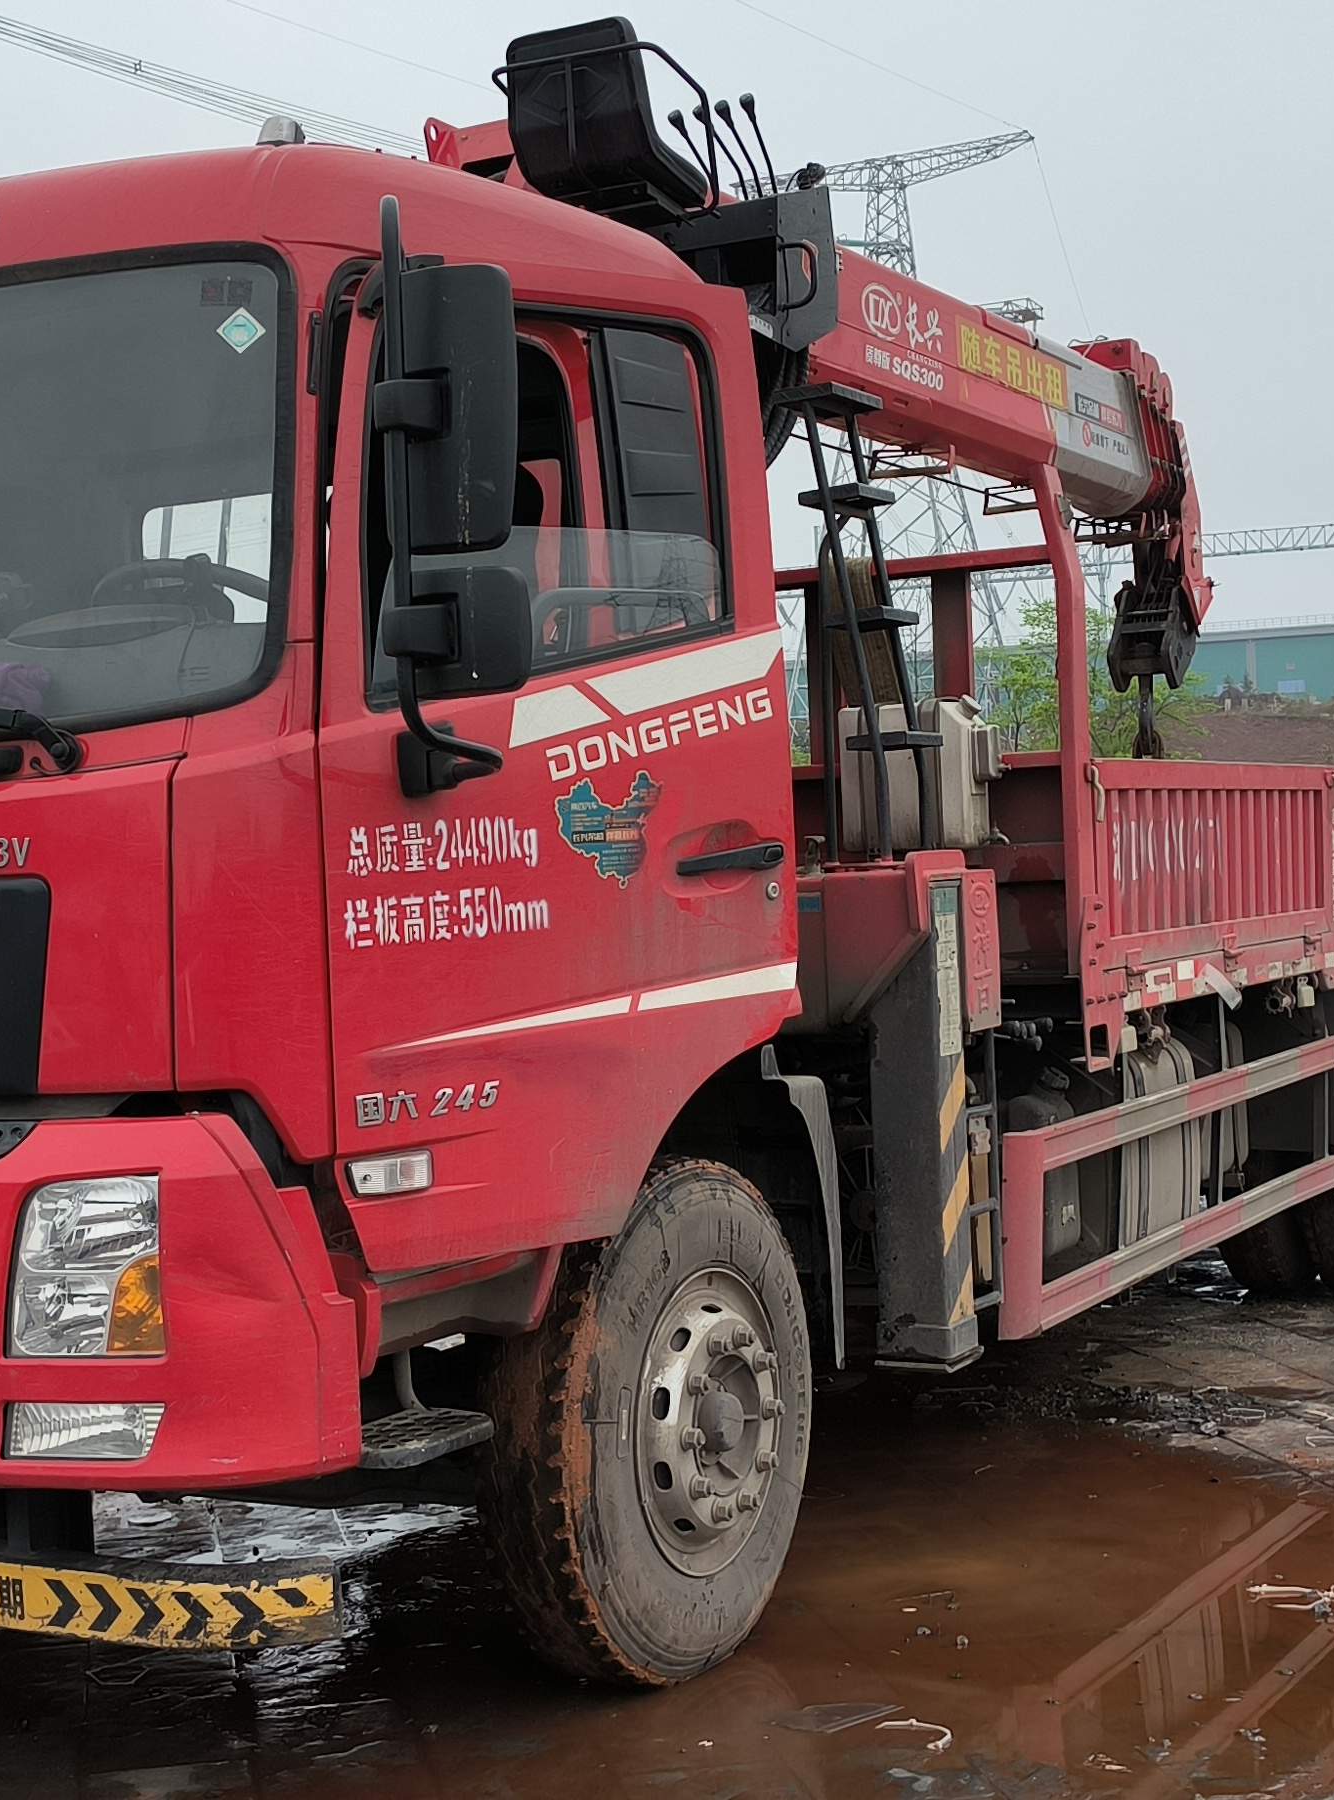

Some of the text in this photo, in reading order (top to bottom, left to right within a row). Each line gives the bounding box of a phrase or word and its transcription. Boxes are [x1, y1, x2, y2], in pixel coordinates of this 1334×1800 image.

[892, 357, 943, 391] SQS300
[960, 324, 1064, 406] 随车吊出租
[545, 687, 774, 781] DONGFENG
[355, 1080, 500, 1128] 国六 245
